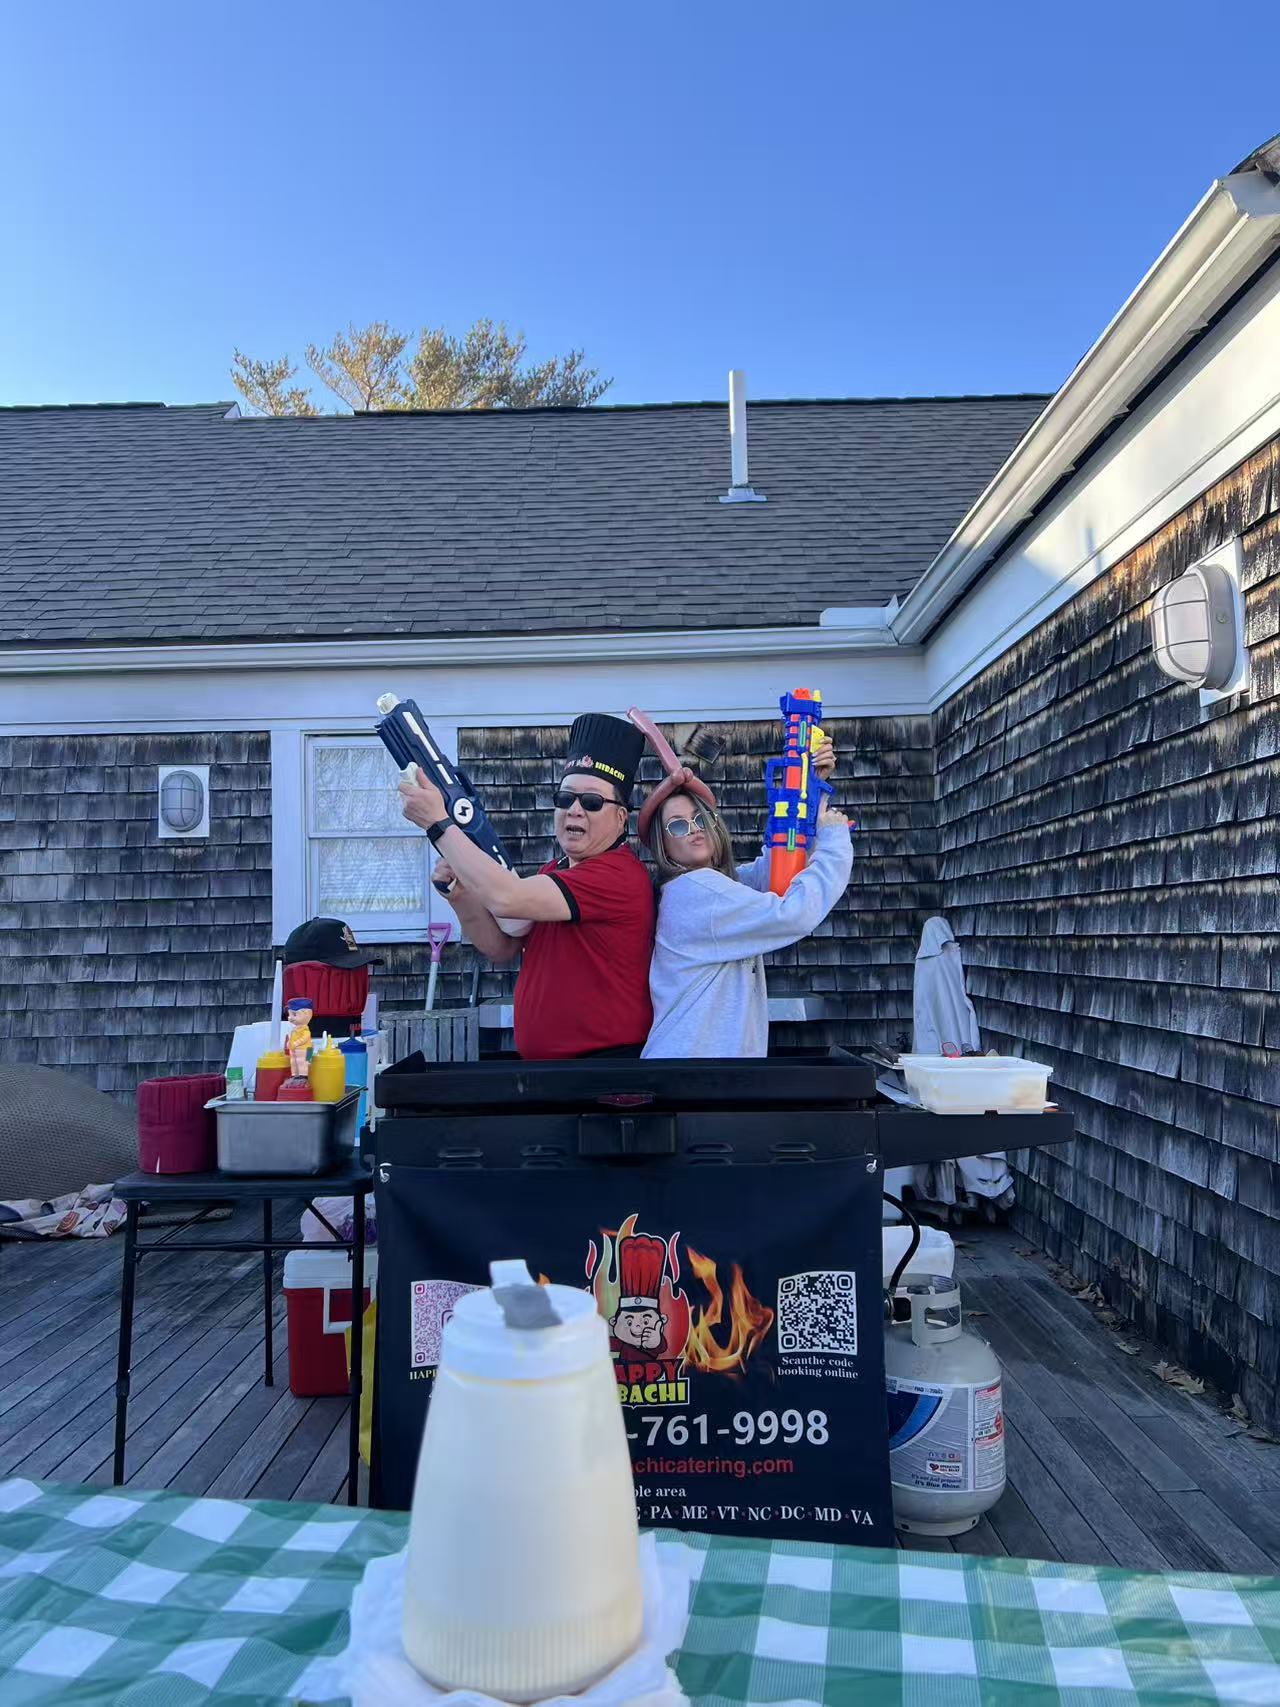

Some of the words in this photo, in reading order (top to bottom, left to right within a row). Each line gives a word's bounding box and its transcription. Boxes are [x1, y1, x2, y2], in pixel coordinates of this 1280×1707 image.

[828, 1358, 854, 1368] code
[777, 1366, 822, 1378] booking
[824, 1368, 859, 1379] online
[655, 1487, 687, 1497] area
[650, 1505, 673, 1520] PA
[681, 1505, 708, 1520] ME
[717, 1506, 739, 1520] VT
[747, 1506, 772, 1521] NC
[780, 1505, 806, 1520] DC
[814, 1506, 842, 1522] MD
[850, 1509, 874, 1526] VA
